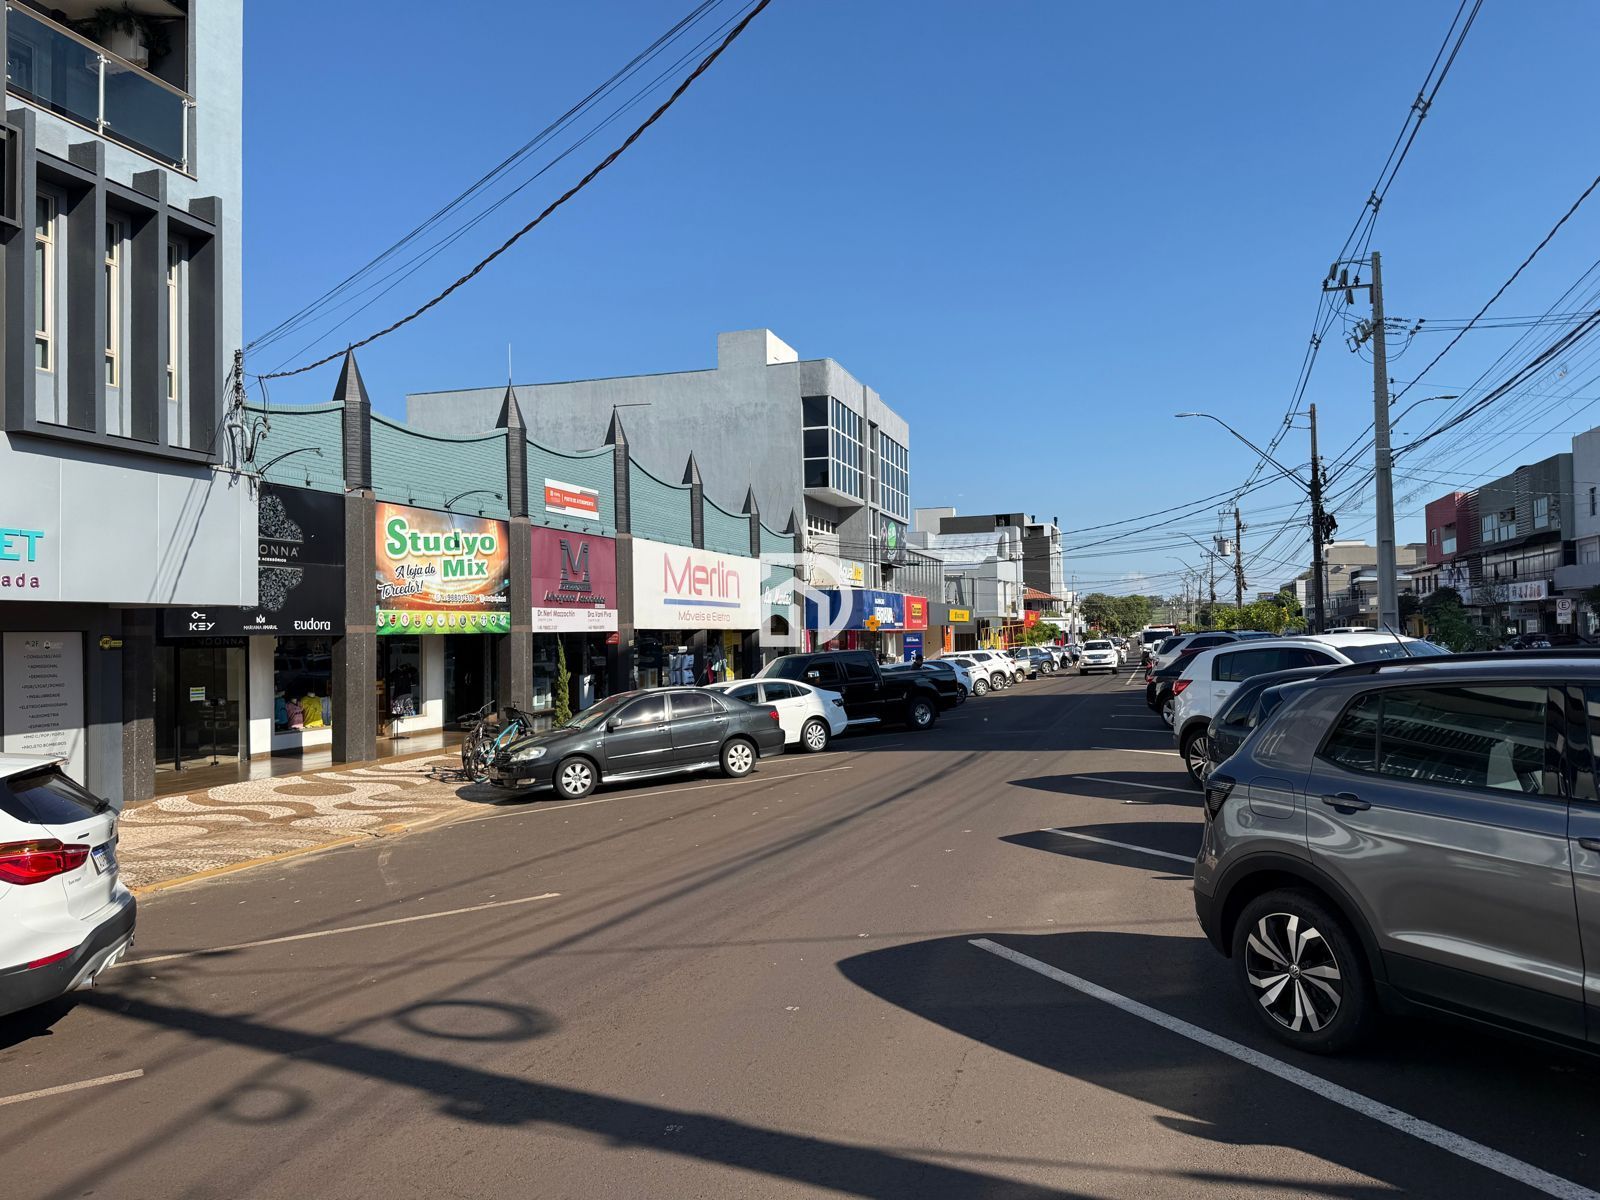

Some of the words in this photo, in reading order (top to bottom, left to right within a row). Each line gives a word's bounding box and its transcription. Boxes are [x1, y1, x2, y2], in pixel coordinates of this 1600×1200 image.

[387, 519, 495, 555] Studyo
[407, 564, 423, 579] loja
[424, 562, 436, 574] do
[443, 558, 487, 578] Mix
[664, 552, 740, 598] Merlin
[377, 580, 424, 598] Torcedor!
[294, 618, 331, 630] eudora
[678, 610, 706, 622] Móveis
[706, 613, 712, 622] e
[712, 612, 731, 622] Eletro
[189, 622, 216, 631] KEY
